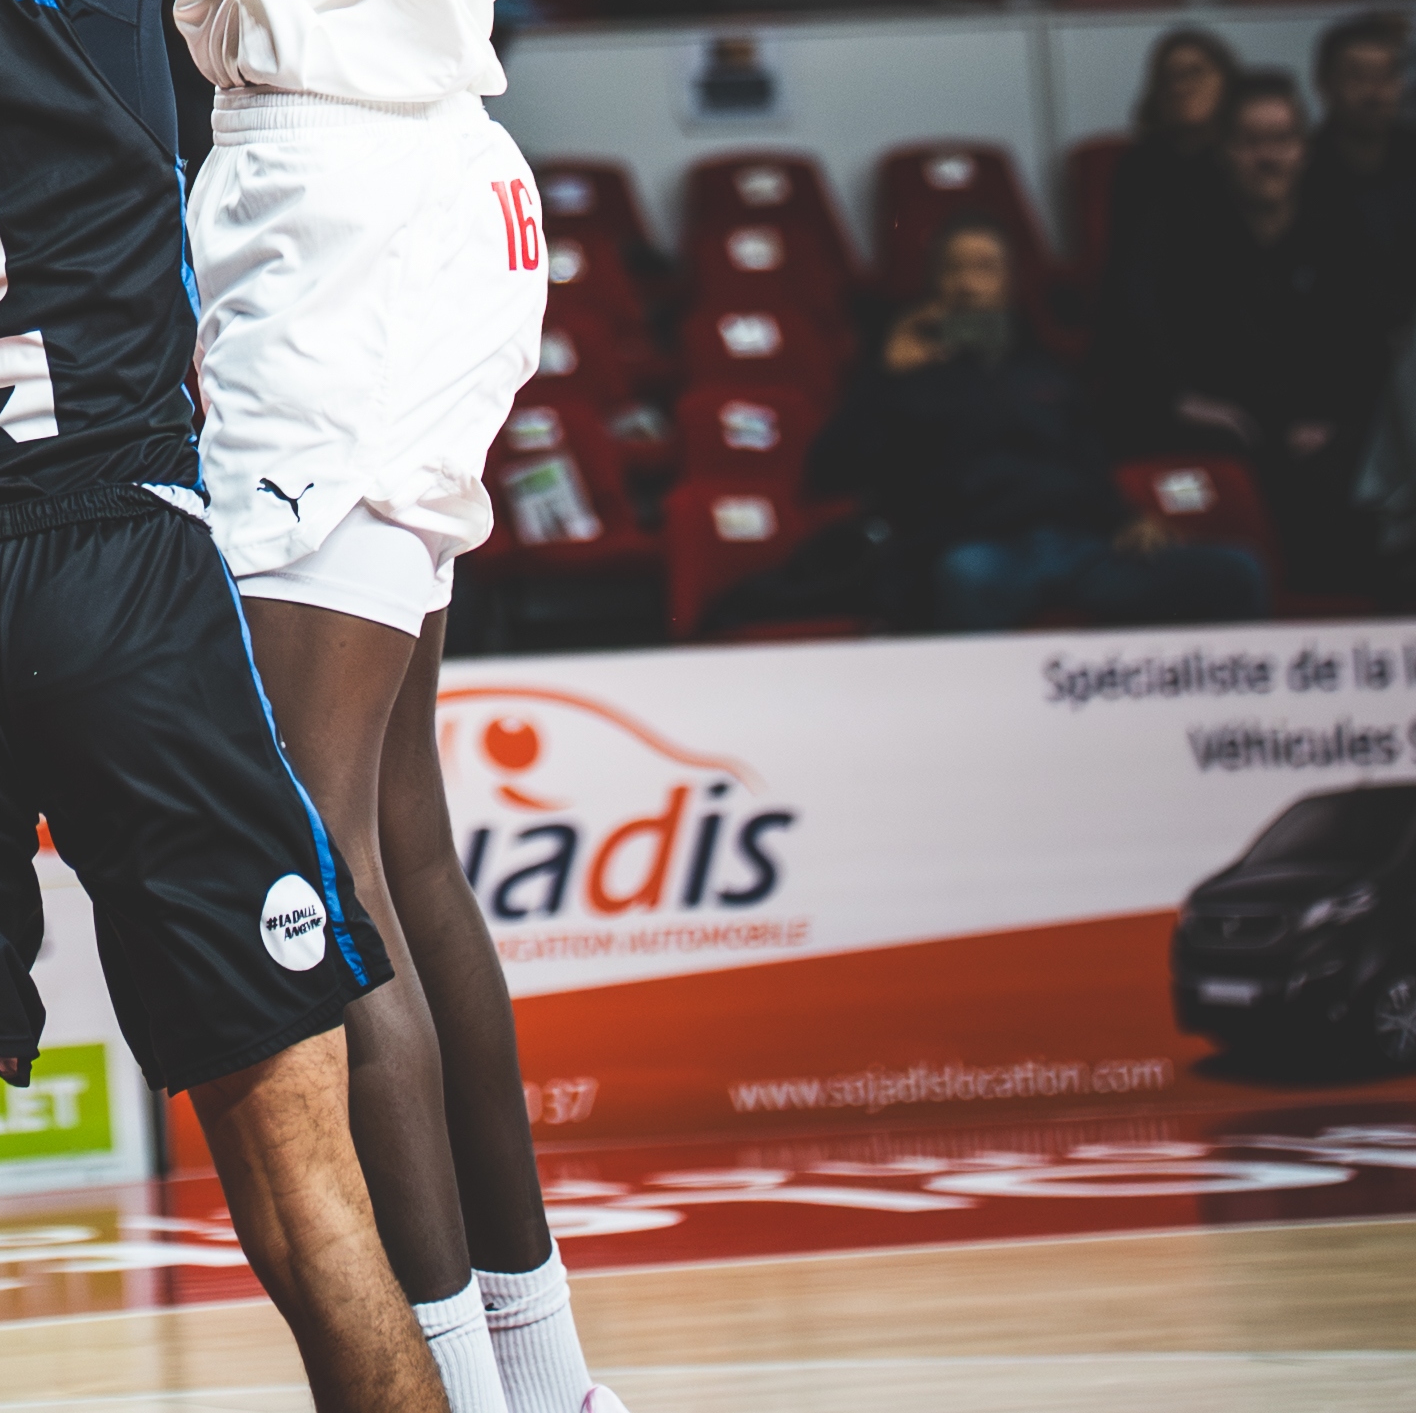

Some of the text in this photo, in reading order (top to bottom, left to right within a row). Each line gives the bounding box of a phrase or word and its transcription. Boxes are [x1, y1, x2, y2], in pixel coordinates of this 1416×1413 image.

[492, 178, 539, 272] 16
[1286, 639, 1342, 693] de
[1351, 639, 1396, 691] la
